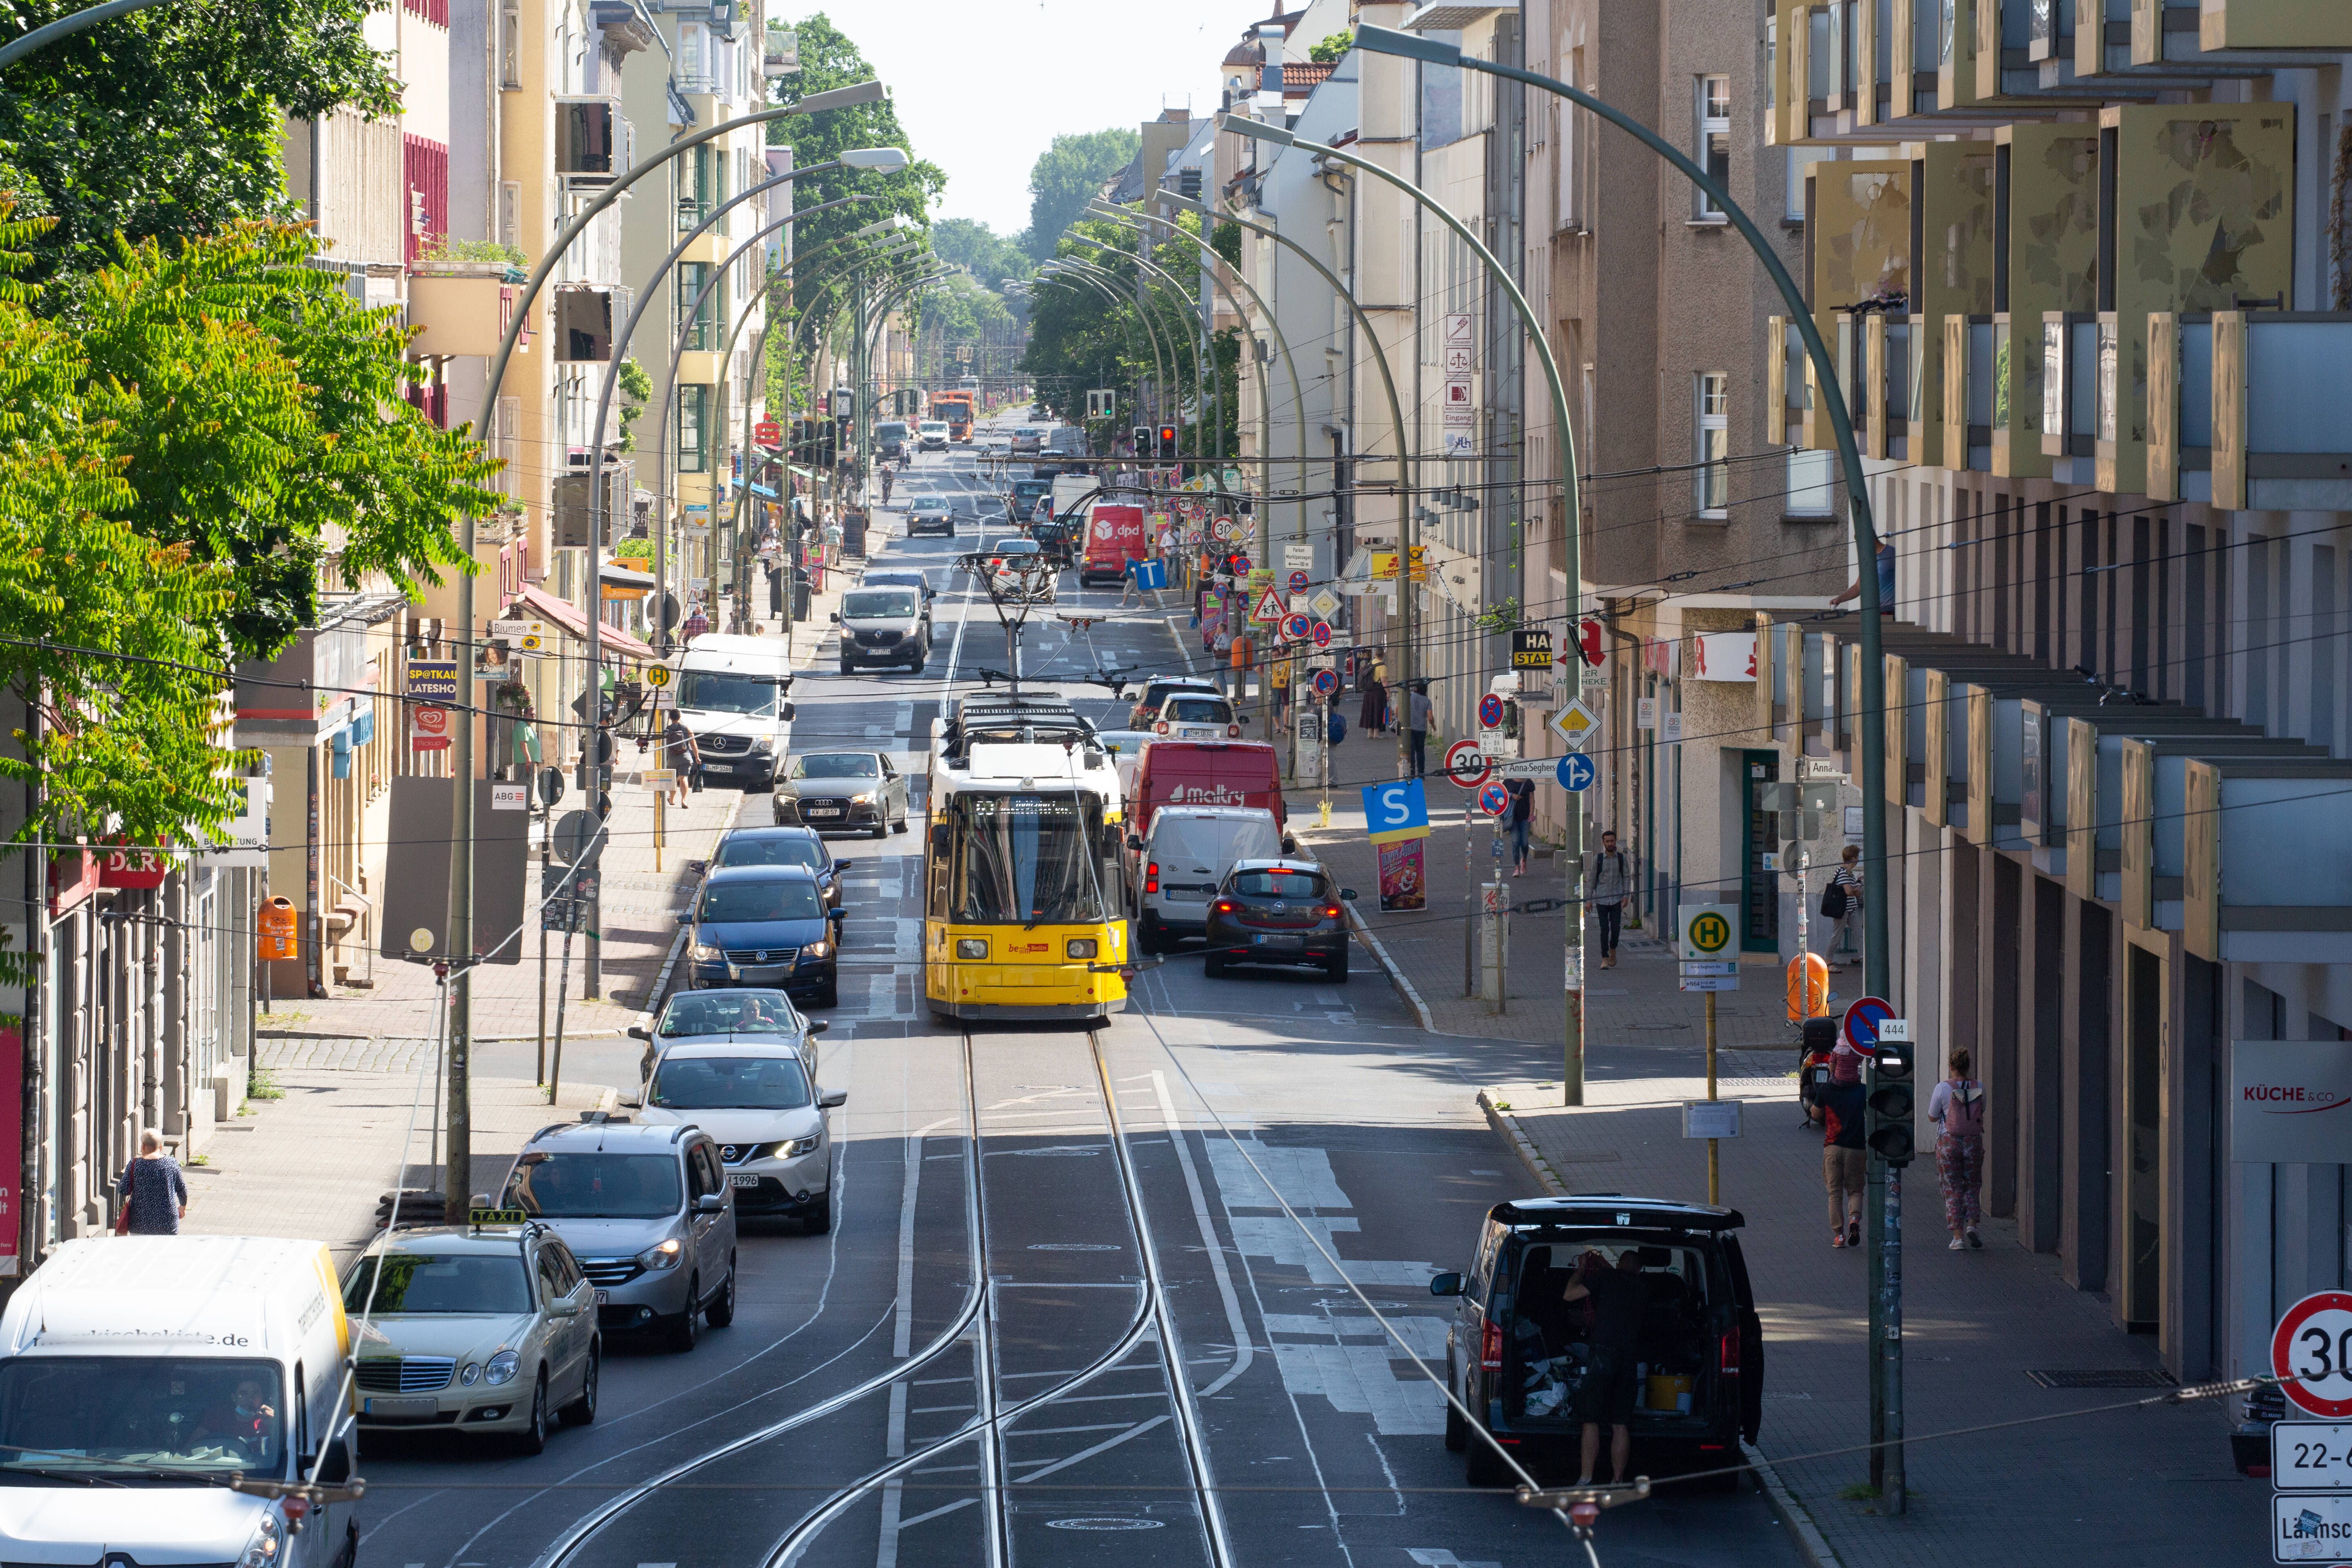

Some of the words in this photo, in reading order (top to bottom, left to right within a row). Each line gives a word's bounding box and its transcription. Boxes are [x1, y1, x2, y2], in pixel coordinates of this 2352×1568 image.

[1117, 525, 1139, 537] dpd
[1217, 523, 1232, 535] 30
[1141, 561, 1157, 586] T
[494, 623, 526, 633] Blumen
[408, 684, 456, 693] LATESHO
[1455, 754, 1482, 770] 30
[494, 792, 513, 800] ABG
[1382, 788, 1410, 824] S
[1382, 841, 1403, 853] CIRCUS
[1390, 860, 1402, 868] Circus
[1700, 921, 1719, 943] H
[1009, 944, 1019, 953] be
[1884, 1025, 1904, 1035] 444
[2244, 1084, 2305, 1101] KÜCHE
[2308, 1092, 2315, 1101] &
[2317, 1092, 2334, 1102] CO
[733, 1176, 757, 1185] 1996
[478, 1211, 516, 1222] TAXI
